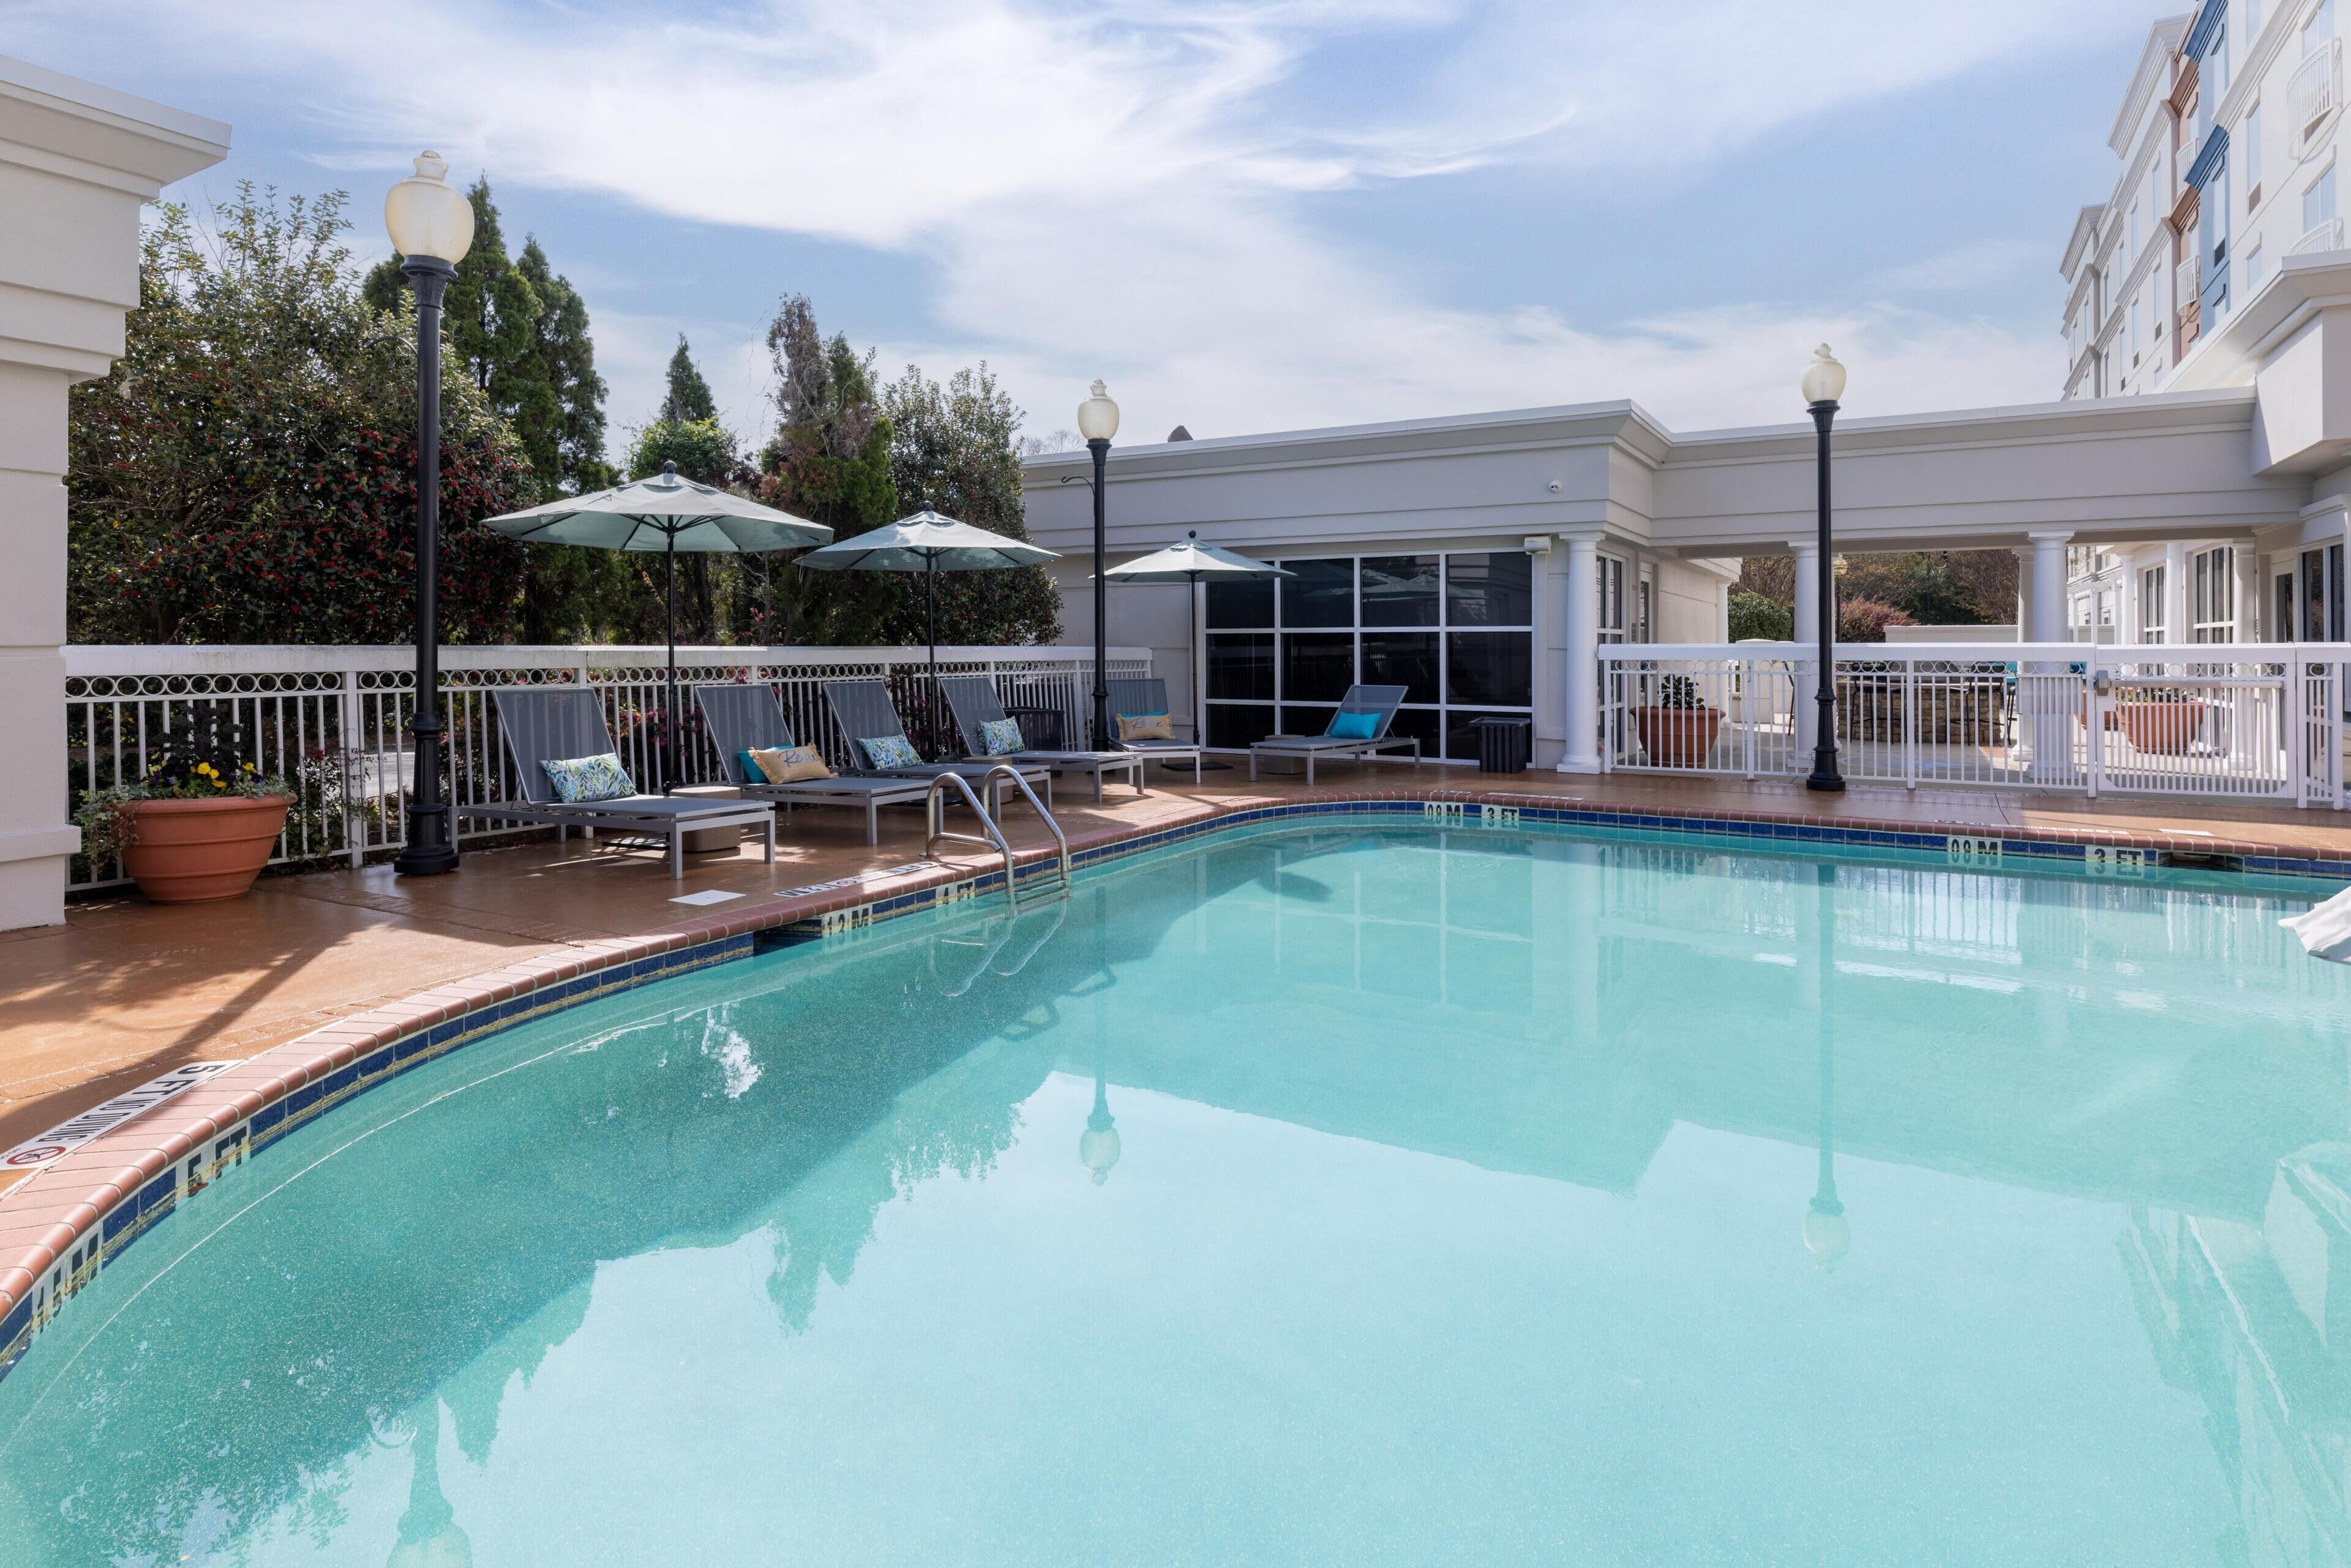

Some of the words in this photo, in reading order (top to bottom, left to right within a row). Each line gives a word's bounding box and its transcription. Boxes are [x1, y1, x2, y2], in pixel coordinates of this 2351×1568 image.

[1501, 808, 1518, 820] FT
[2116, 849, 2142, 865] FT
[131, 1079, 197, 1096] FT
[98, 1098, 159, 1111] NO
[35, 1112, 132, 1143] DIVING
